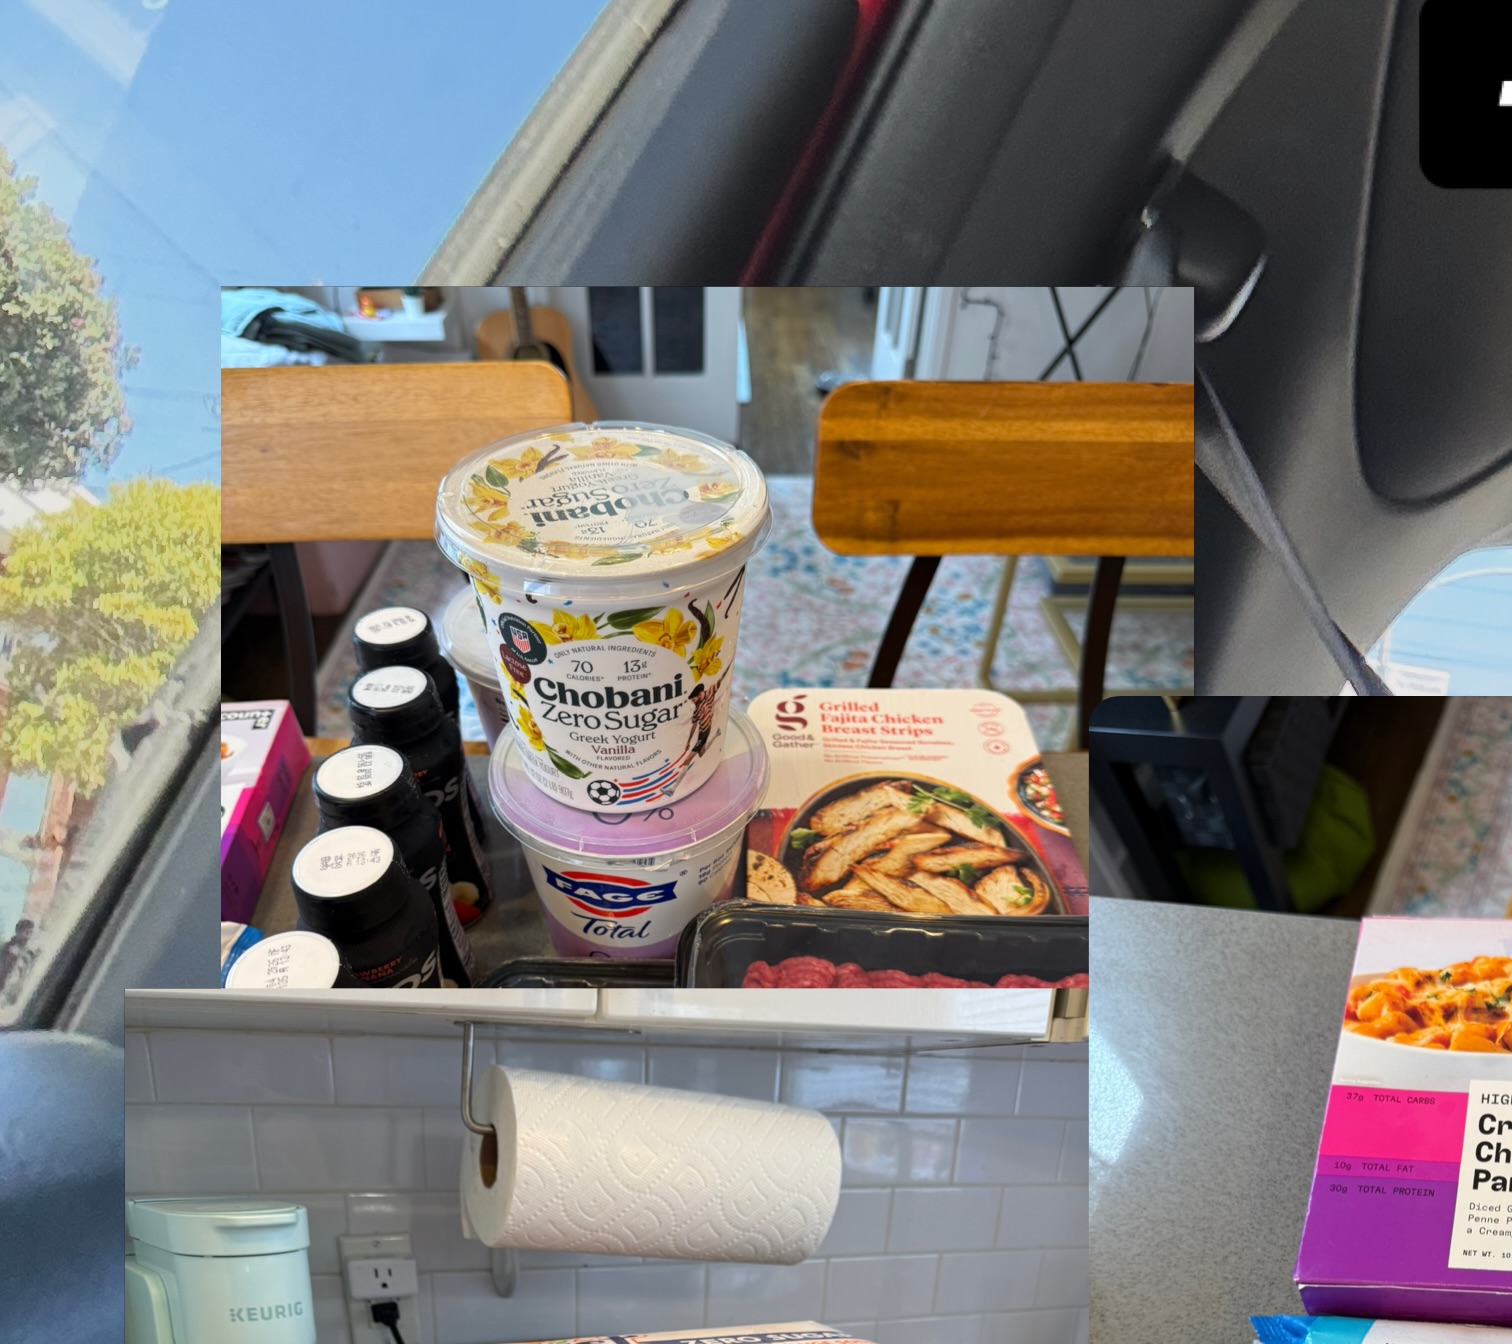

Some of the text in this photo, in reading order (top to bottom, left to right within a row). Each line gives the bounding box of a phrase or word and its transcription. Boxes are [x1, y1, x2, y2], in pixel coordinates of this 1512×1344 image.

[531, 487, 689, 527] Chobani
[571, 645, 606, 655] NATURAL
[570, 659, 648, 674] 70 13g
[533, 673, 684, 709] Chobani
[819, 702, 880, 713] Grilled
[540, 701, 600, 730] Zero
[872, 714, 944, 725] Chicken
[821, 724, 934, 737] Breast Strips
[569, 731, 656, 745] Greek Yogurt
[591, 745, 636, 755] Vanilla
[772, 741, 815, 749] Gather
[570, 911, 651, 939] Total
[1346, 1092, 1436, 1105] 37g TOTAL CARBS
[1333, 1161, 1415, 1173] 10g TOTAL FAT
[1329, 1184, 1436, 1197] 30g TOTAL PROTEIN
[1469, 1202, 1501, 1213] Diced
[1467, 1214, 1500, 1224] Penne
[1462, 1249, 1478, 1257] NET
[229, 1301, 304, 1323] KEURIG
